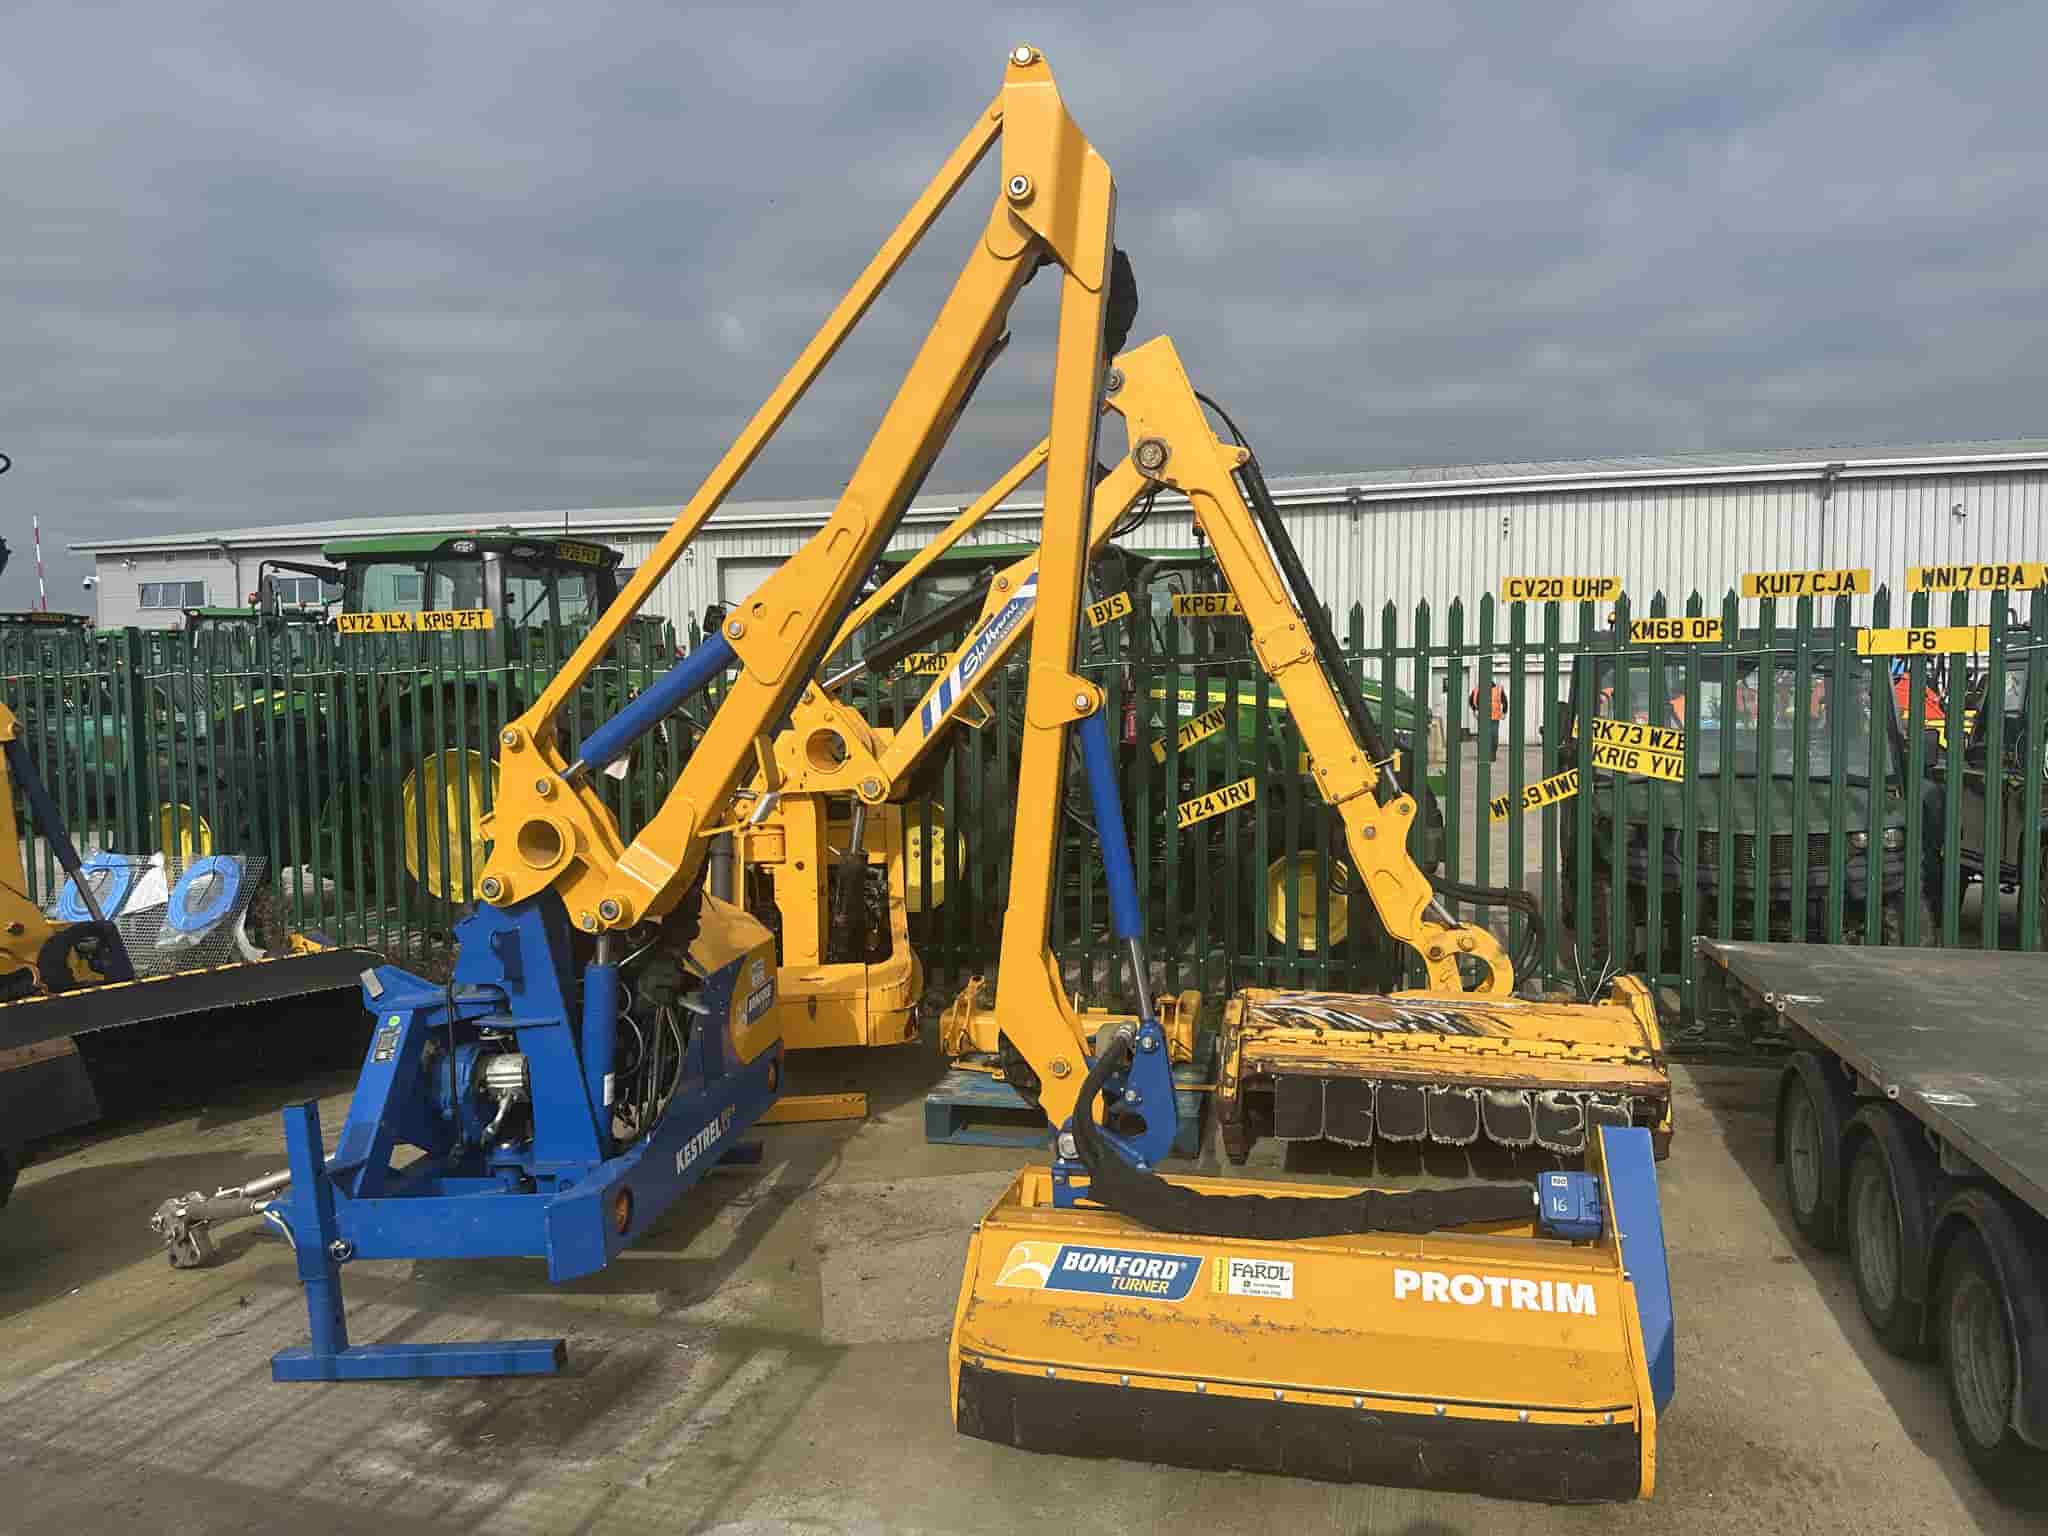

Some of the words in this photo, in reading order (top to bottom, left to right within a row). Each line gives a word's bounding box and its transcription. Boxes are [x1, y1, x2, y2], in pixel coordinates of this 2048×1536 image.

[1756, 574, 1804, 594] KU17
[1812, 572, 1856, 592] CJA
[1922, 567, 1972, 588] WN17
[1510, 579, 1563, 598] CV20
[1573, 579, 1613, 597] UHP
[340, 615, 374, 631] CV72
[382, 614, 407, 629] VLX
[1693, 620, 1724, 639] OP
[1907, 631, 1936, 650] P6
[1593, 744, 1640, 768] KR16
[1217, 782, 1250, 806] VRV
[675, 1116, 721, 1176] KESTREL
[1062, 1252, 1180, 1279] BOMFORD
[1111, 1276, 1169, 1294] TURNER
[1394, 1268, 1597, 1316] PROTRIM
